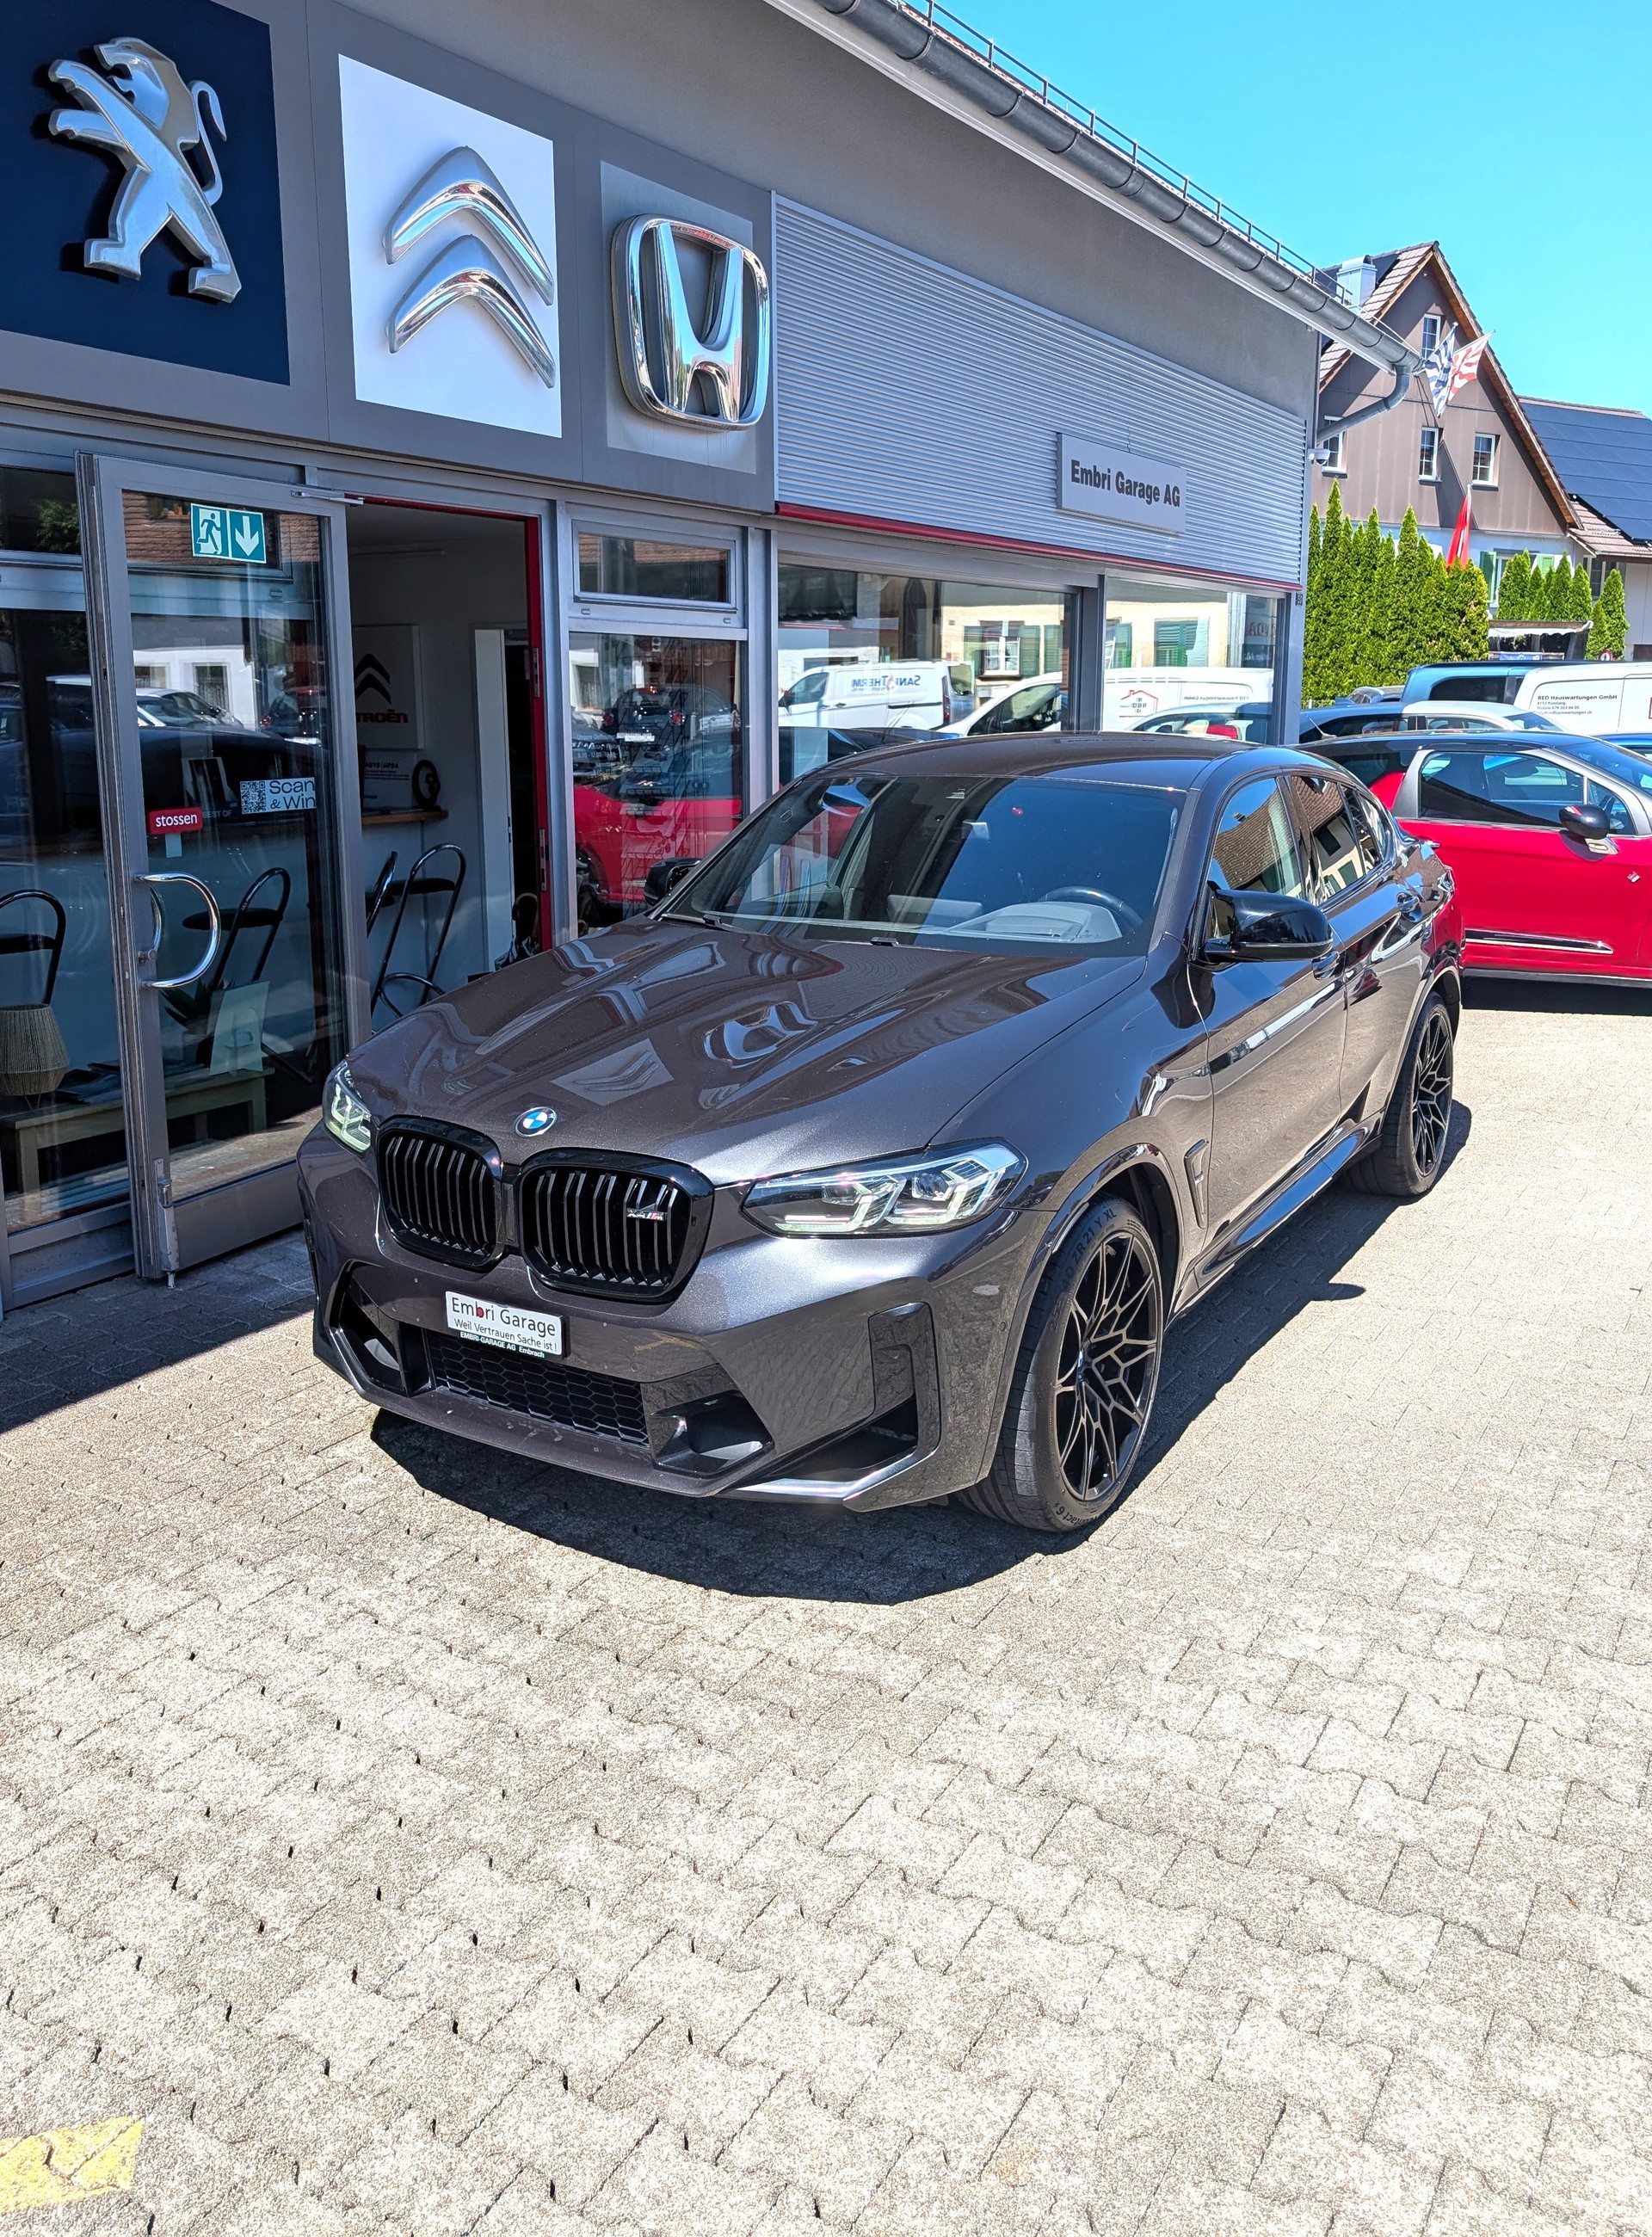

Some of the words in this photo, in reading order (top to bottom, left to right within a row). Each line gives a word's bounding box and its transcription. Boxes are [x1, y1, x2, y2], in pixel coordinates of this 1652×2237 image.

[1071, 459, 1111, 491] Embri
[1115, 471, 1161, 505] Garage
[1163, 484, 1180, 508] AG
[269, 780, 315, 795] Scan
[270, 798, 281, 810] &
[283, 793, 316, 810] Win
[156, 814, 198, 827] stossen
[1071, 1243, 1087, 1262] ZR
[1082, 1226, 1095, 1242] 21
[1094, 1217, 1103, 1229] Y
[1104, 1208, 1117, 1221] XL
[452, 1297, 495, 1321] Embri
[500, 1309, 556, 1337] Garage
[454, 1317, 472, 1331] Weil
[474, 1322, 515, 1341] Vertrauen
[517, 1334, 541, 1348] Sache
[544, 1340, 553, 1352] ist
[460, 1331, 506, 1348] EMBRI-GARAGE
[507, 1343, 516, 1352] AG
[519, 1346, 545, 1359] Embrach
